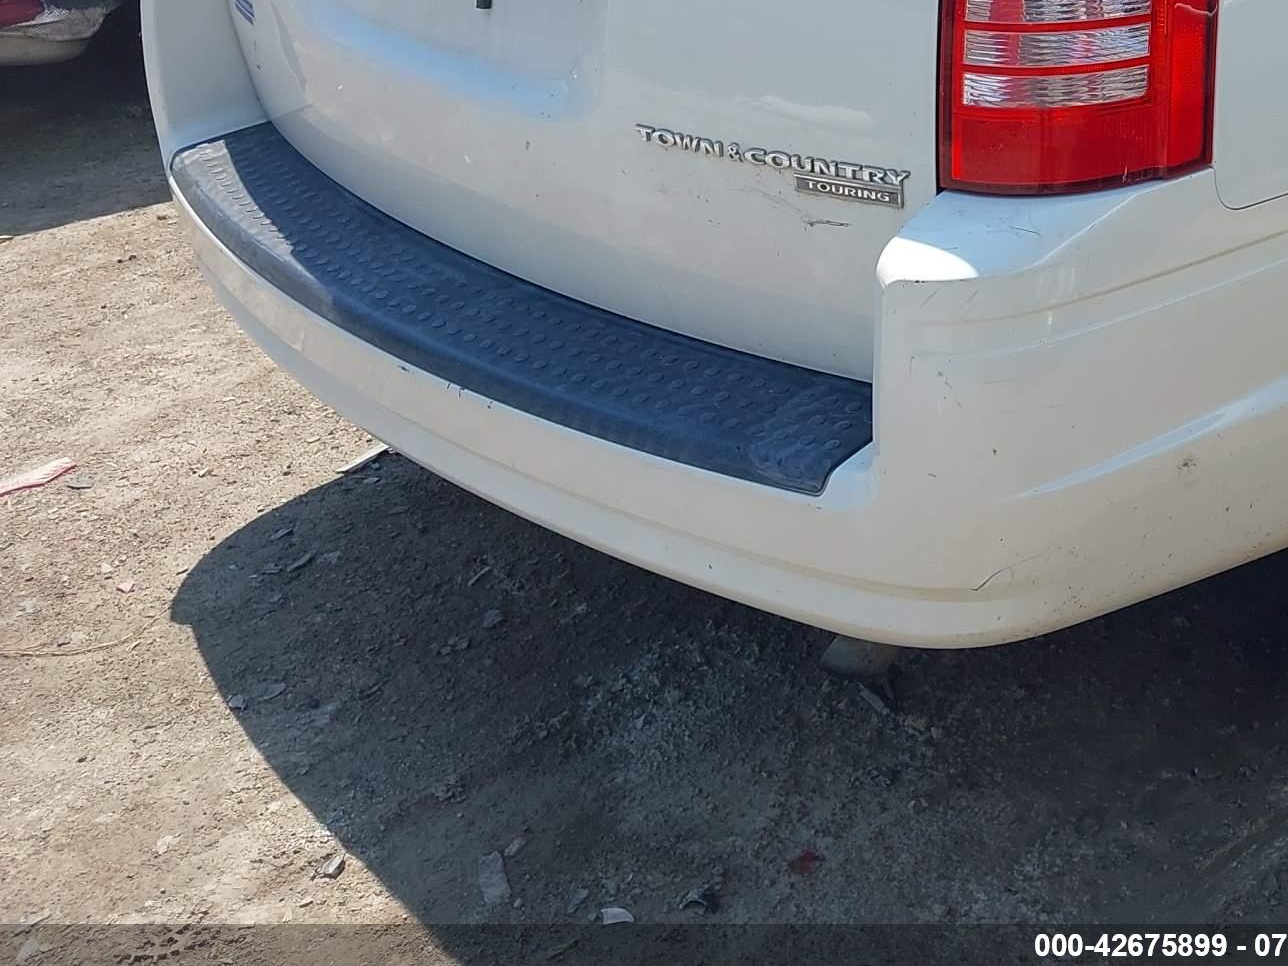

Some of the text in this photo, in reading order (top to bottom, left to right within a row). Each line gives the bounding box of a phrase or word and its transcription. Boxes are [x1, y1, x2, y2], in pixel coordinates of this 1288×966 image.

[634, 123, 911, 185] TOWN & COUNTRY
[806, 179, 891, 203] TOURING
